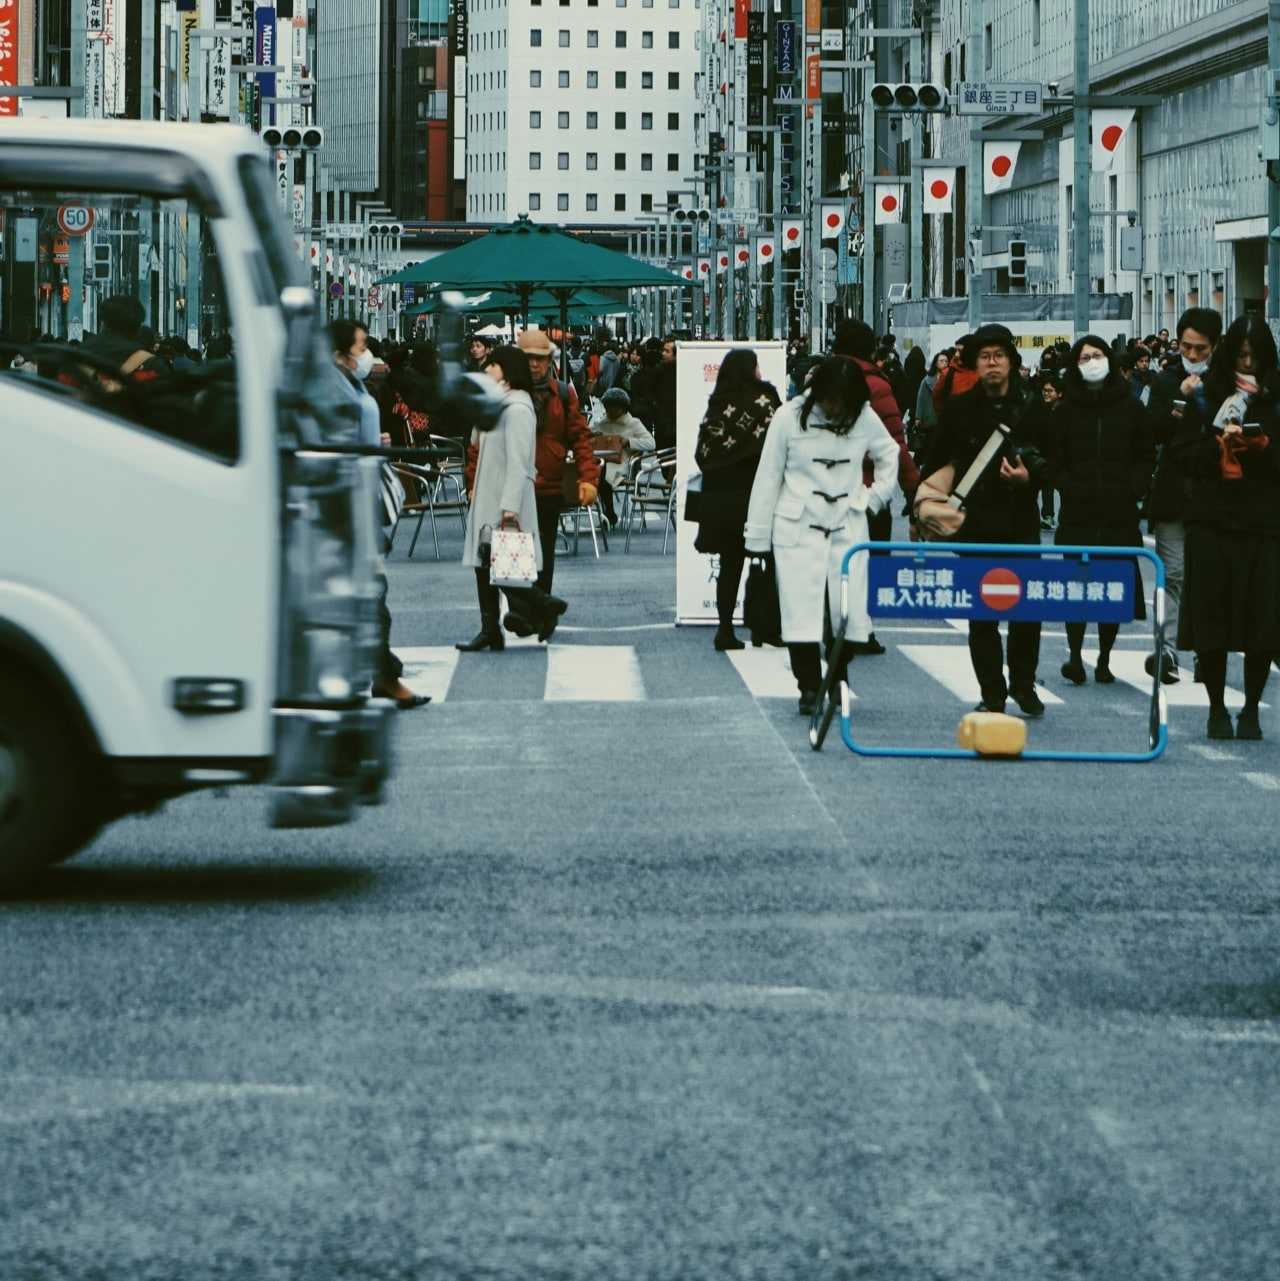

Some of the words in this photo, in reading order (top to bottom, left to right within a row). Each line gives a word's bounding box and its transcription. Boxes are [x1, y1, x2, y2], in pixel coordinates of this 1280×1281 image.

[963, 90, 1038, 104] 銀座三丁目
[985, 104, 1007, 112] Ginza
[1009, 104, 1015, 112] 3
[64, 208, 87, 227] 50
[895, 568, 954, 587] 自転車
[876, 587, 973, 608] 乗入れ禁止
[1025, 580, 1126, 602] 築地警察署
